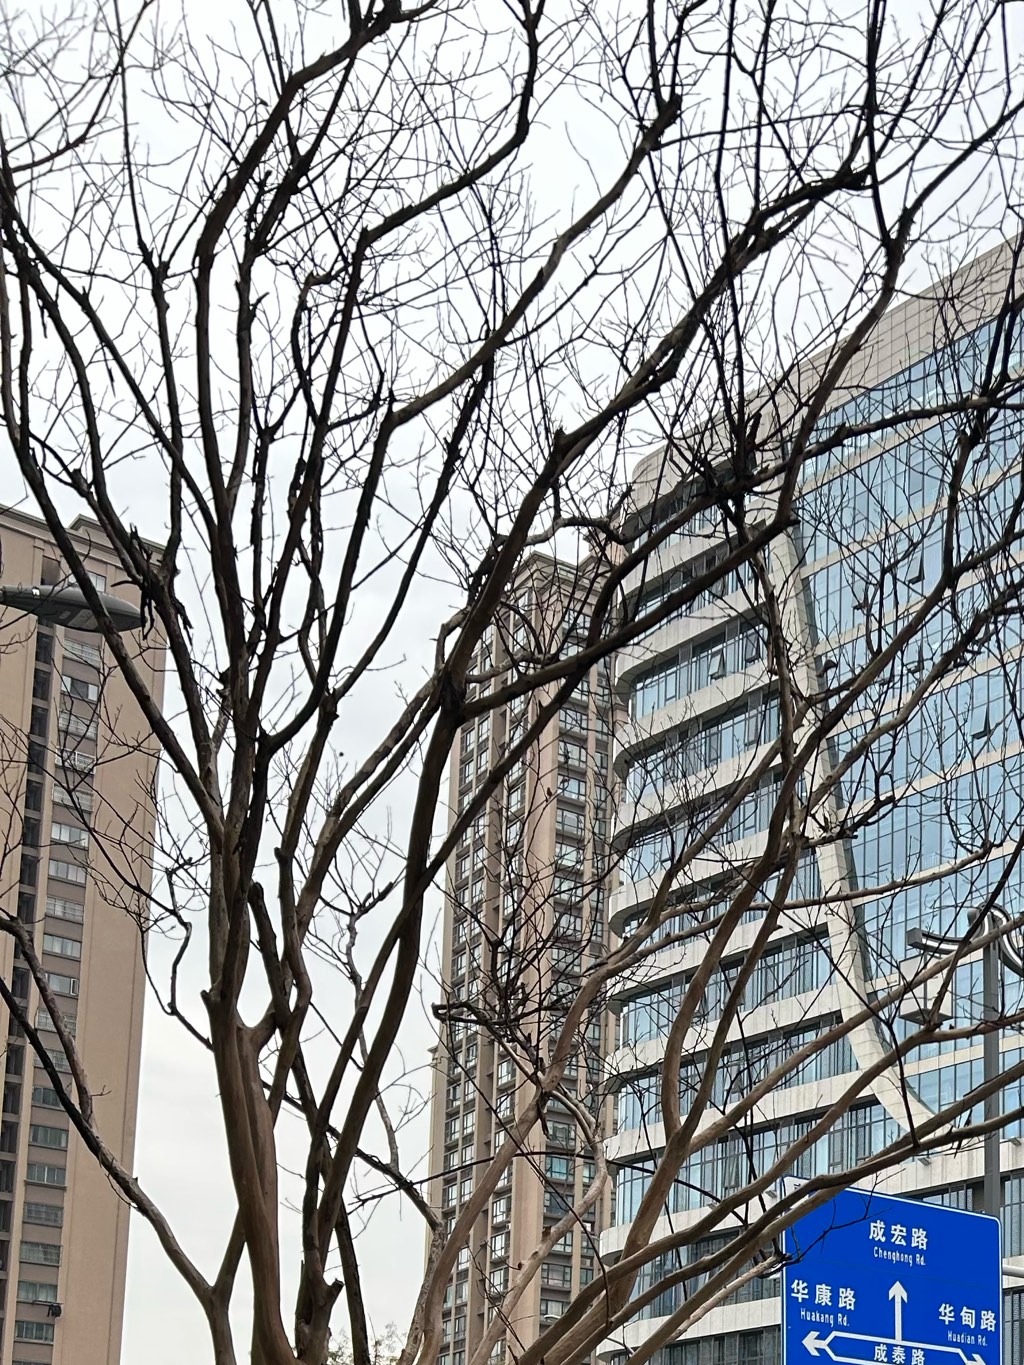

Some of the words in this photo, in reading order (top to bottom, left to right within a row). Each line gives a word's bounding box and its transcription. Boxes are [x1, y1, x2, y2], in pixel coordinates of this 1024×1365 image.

[869, 1220, 928, 1250] 成宏路
[873, 1246, 913, 1267] Chenghong
[916, 1254, 927, 1266] Rd.
[791, 1279, 856, 1311] 华康路
[800, 1308, 834, 1328] Huakang
[837, 1313, 850, 1327] Rd.
[938, 1303, 997, 1332] 华甸路
[947, 1330, 976, 1345] Huadian
[977, 1333, 988, 1347] Rd.
